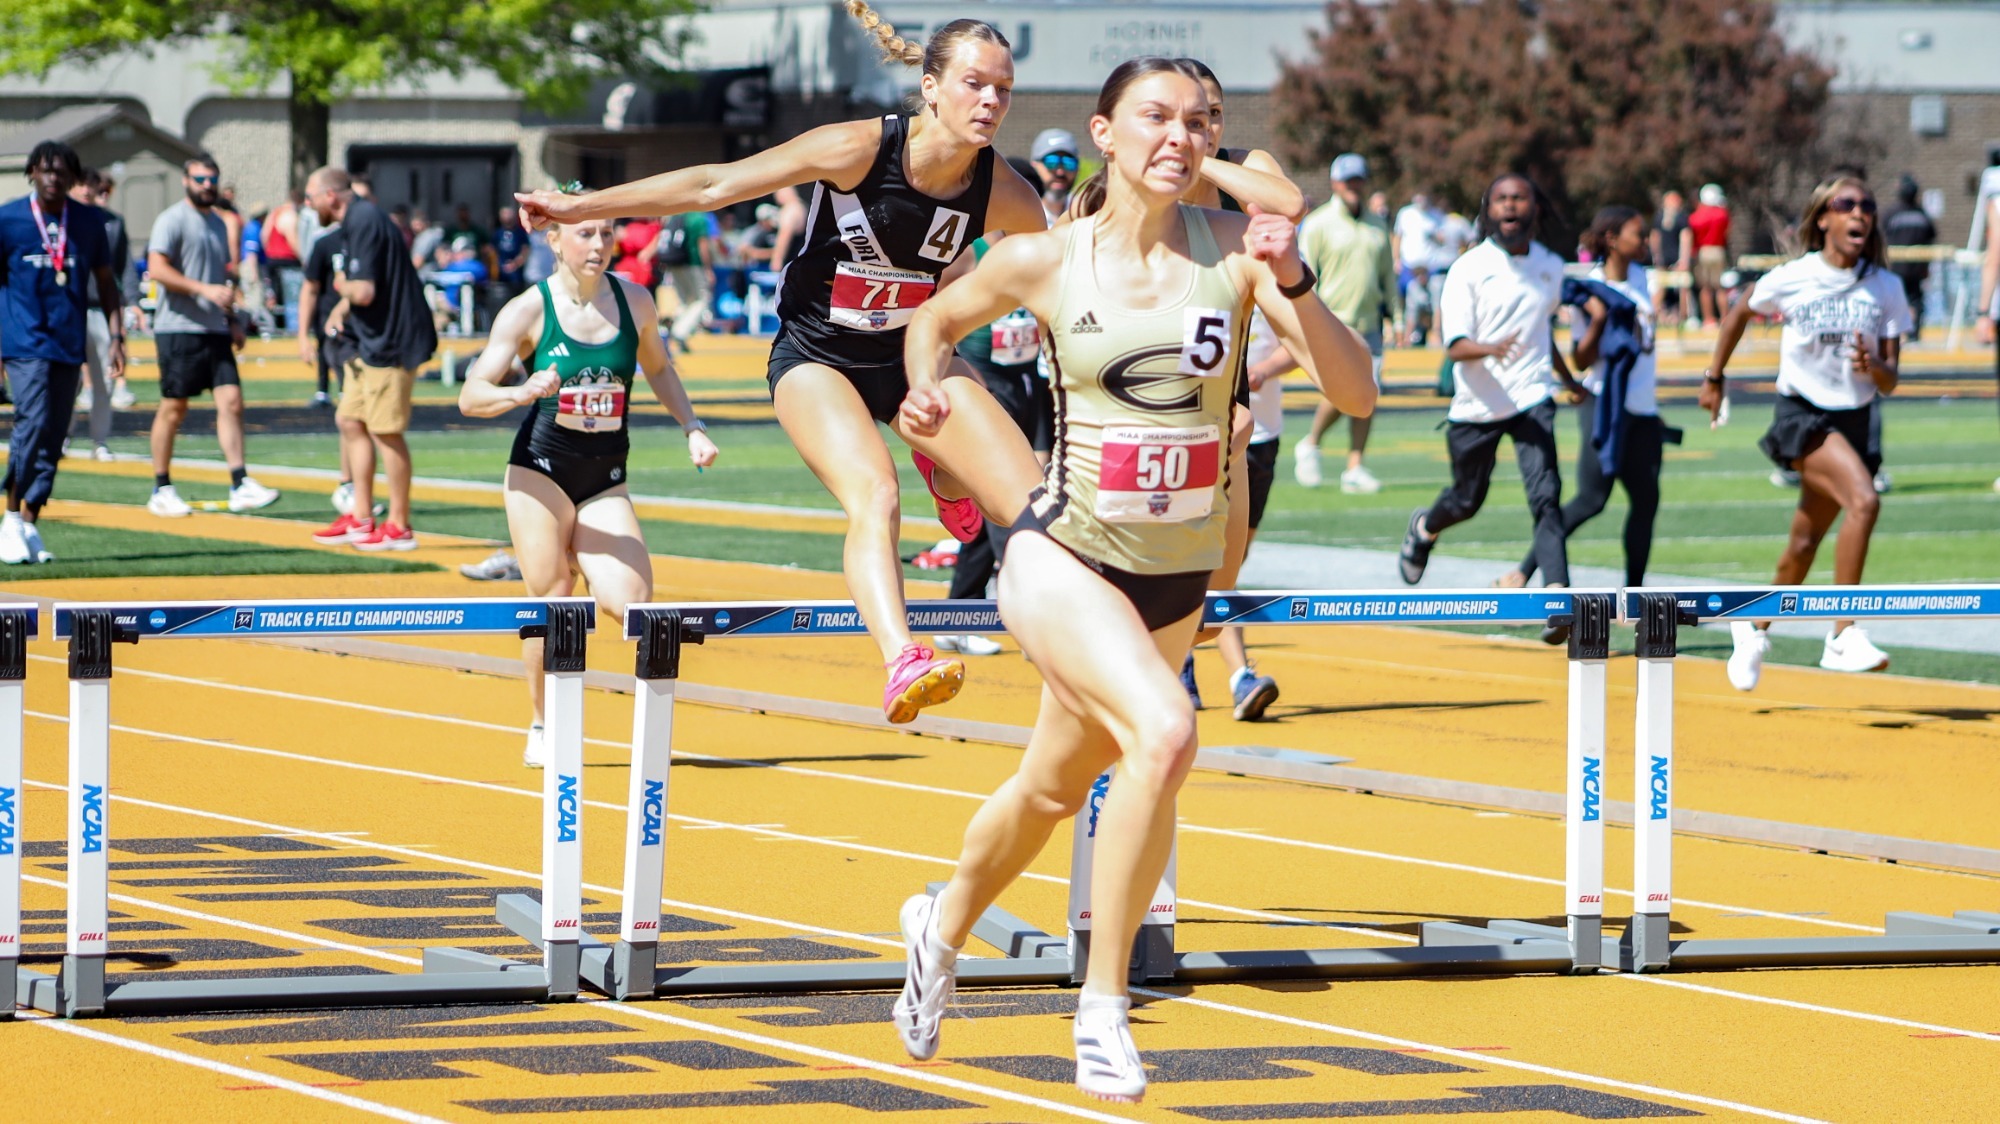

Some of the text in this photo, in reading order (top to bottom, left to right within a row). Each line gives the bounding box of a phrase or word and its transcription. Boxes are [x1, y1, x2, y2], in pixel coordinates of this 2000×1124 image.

[844, 223, 881, 262] FORT
[927, 213, 961, 259] 4
[848, 266, 923, 280] MIAA CHAMPIONSHIPS
[861, 279, 901, 309] 71
[1070, 325, 1103, 334] adidas
[1190, 316, 1225, 371] 5
[572, 393, 614, 417] 150
[1117, 431, 1209, 441] MIAA CHAMPIONSHIPS
[1136, 445, 1190, 490] 50
[1313, 600, 1499, 616] TRACK & FIELD CHAMPIONSHIPS
[1676, 600, 1697, 608] GILL
[1802, 595, 1981, 611] TRACK & FIELD CHAMPIONSHIPS
[114, 616, 137, 625] GILL
[260, 610, 464, 627] TRACK & FIELD CHAMPIONSHIPS
[515, 610, 538, 619] GILL
[682, 616, 704, 625] GILL
[816, 612, 858, 627] TRACK
[908, 611, 1006, 626] CHAMPIONSHIP
[1582, 756, 1600, 822] NCAA
[1650, 755, 1668, 820] NCAA
[557, 774, 577, 842] NCAA
[641, 779, 664, 846] NCAA
[82, 783, 102, 854] NCAA
[1579, 895, 1600, 903] GILL
[1648, 893, 1669, 902] GILL
[1080, 911, 1091, 919] GI
[1151, 904, 1173, 913] GILL
[553, 919, 578, 928] GILL
[633, 921, 657, 929] GILL
[79, 932, 104, 941] GILL
